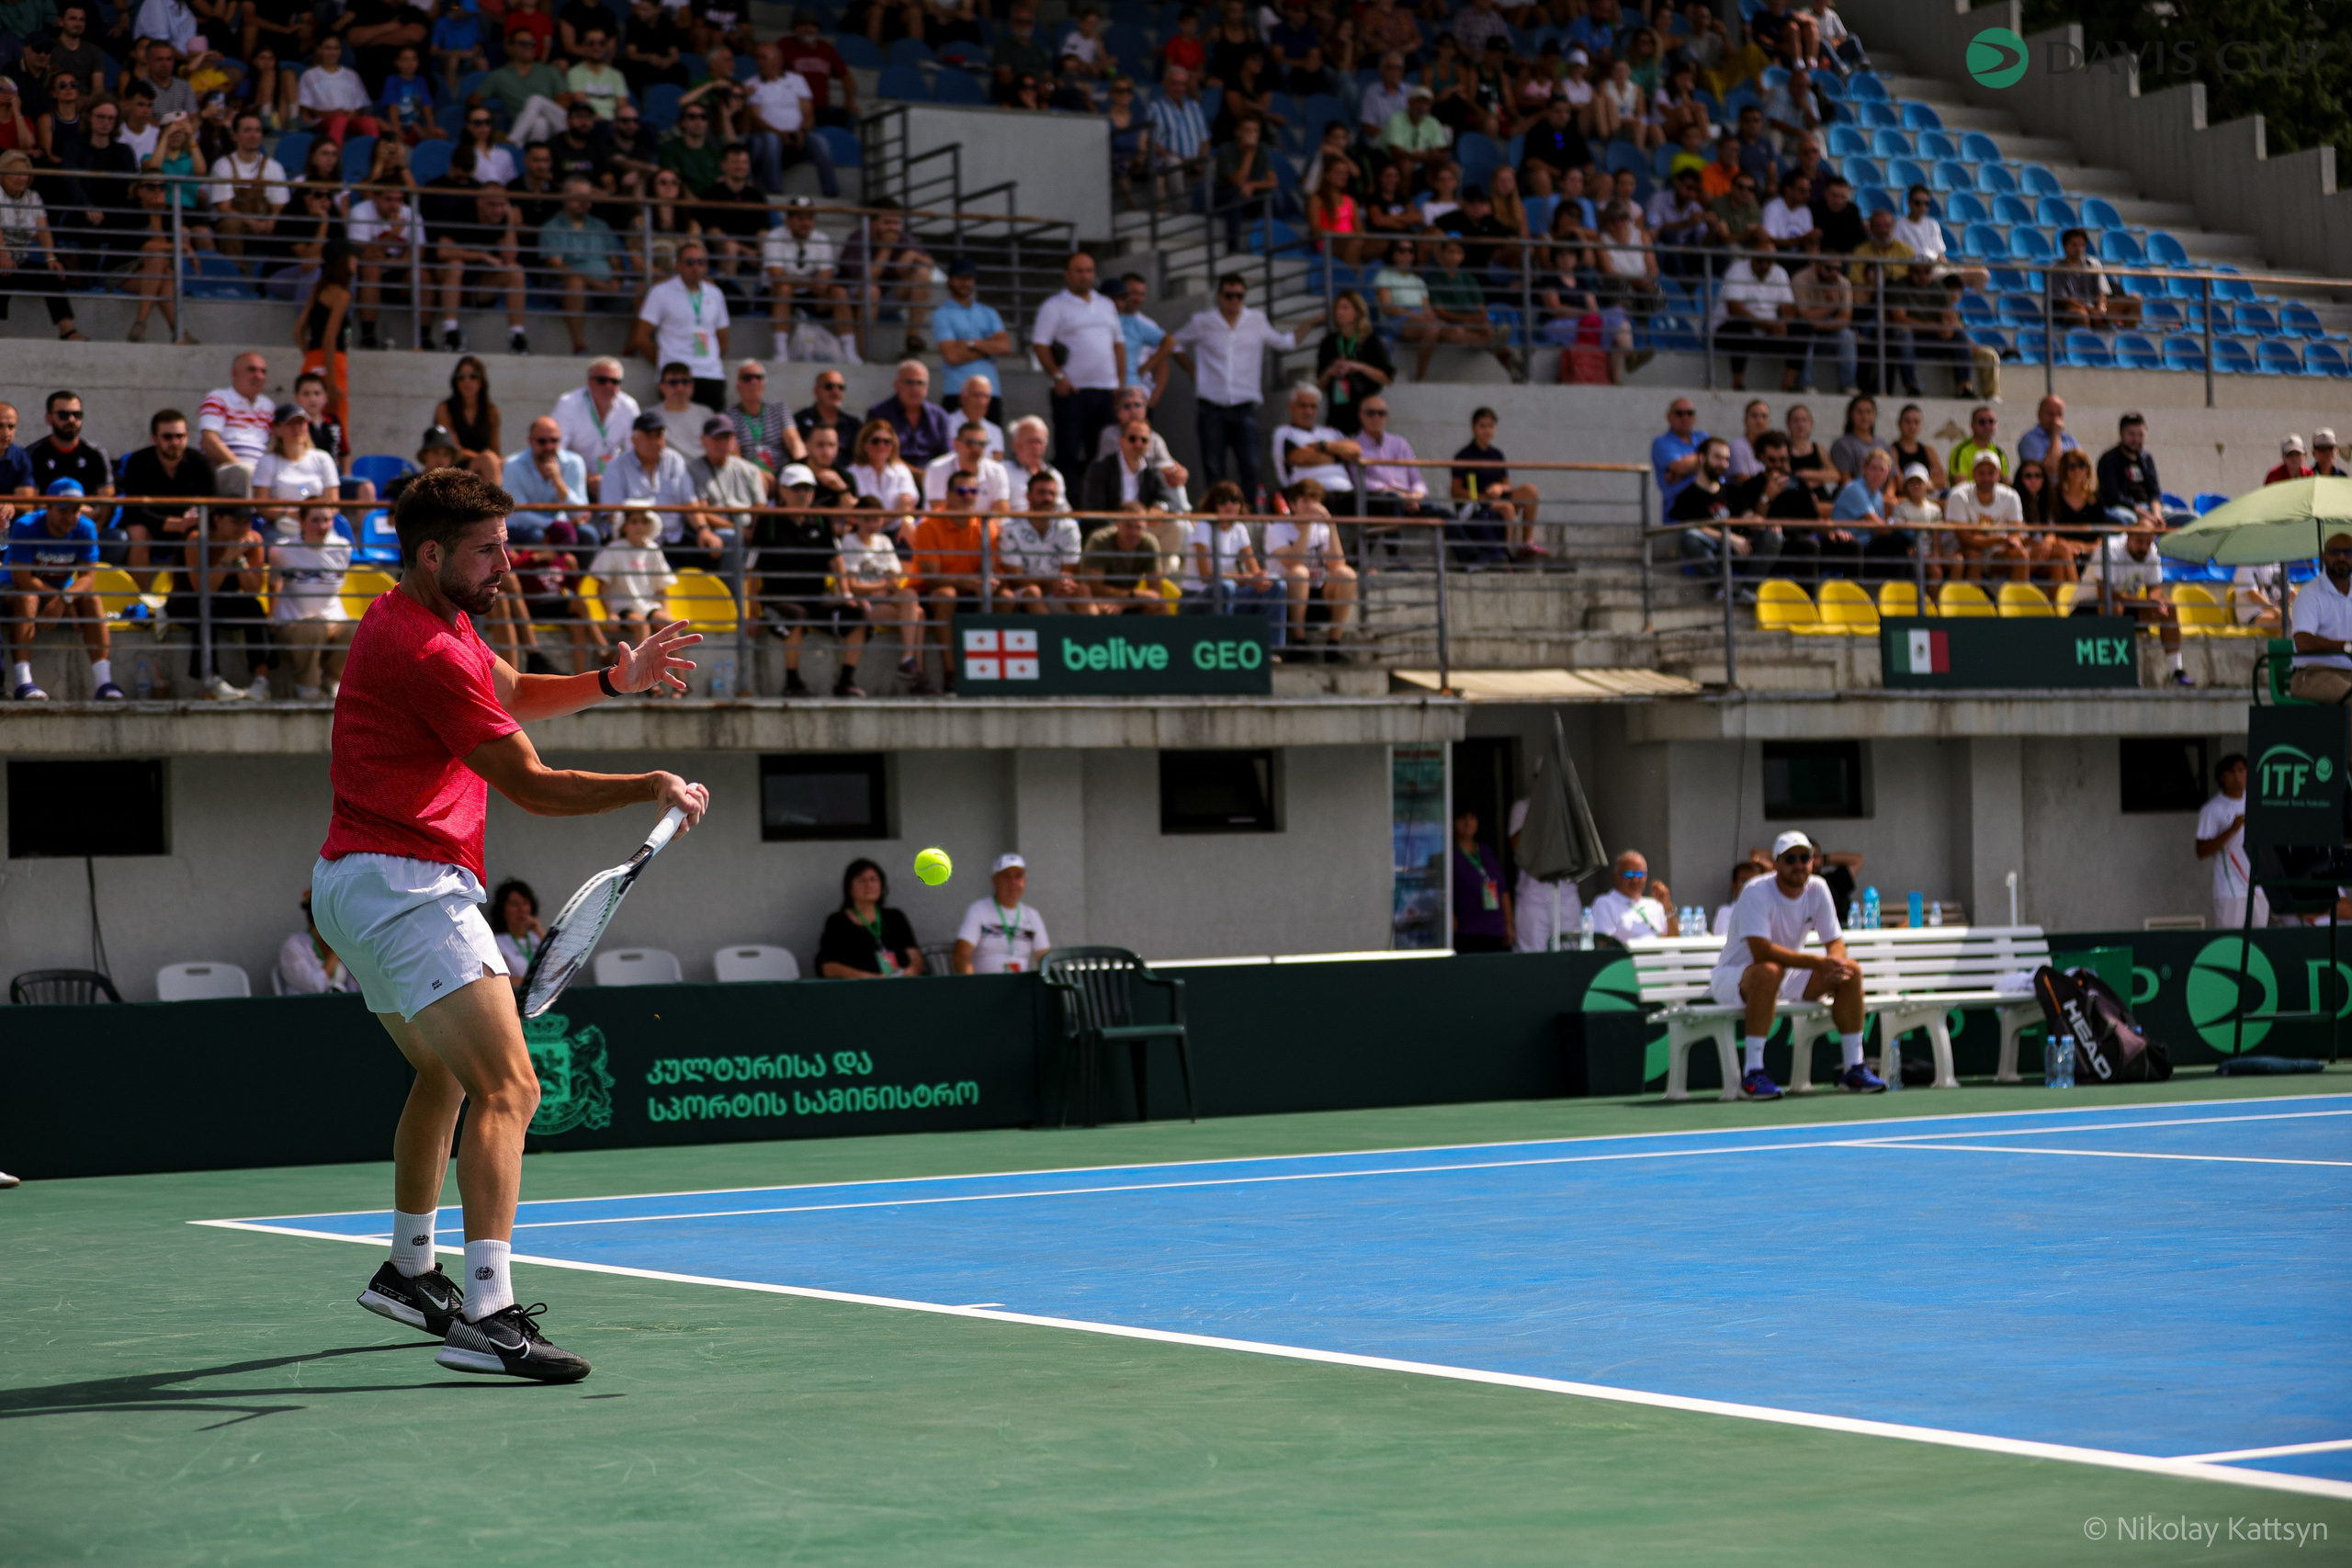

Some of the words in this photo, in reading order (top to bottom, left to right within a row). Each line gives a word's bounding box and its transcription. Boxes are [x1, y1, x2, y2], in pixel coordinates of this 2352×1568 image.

[1063, 637, 1169, 671] belive
[1193, 641, 1261, 670] GEO
[2075, 637, 2130, 665] MEX
[2262, 764, 2310, 797] ITF
[2064, 998, 2112, 1079] HEAD
[647, 1054, 826, 1084] კულტურისა
[833, 1051, 873, 1075] და
[648, 1092, 787, 1122] სპორტის
[794, 1081, 978, 1115] სამინისტრო
